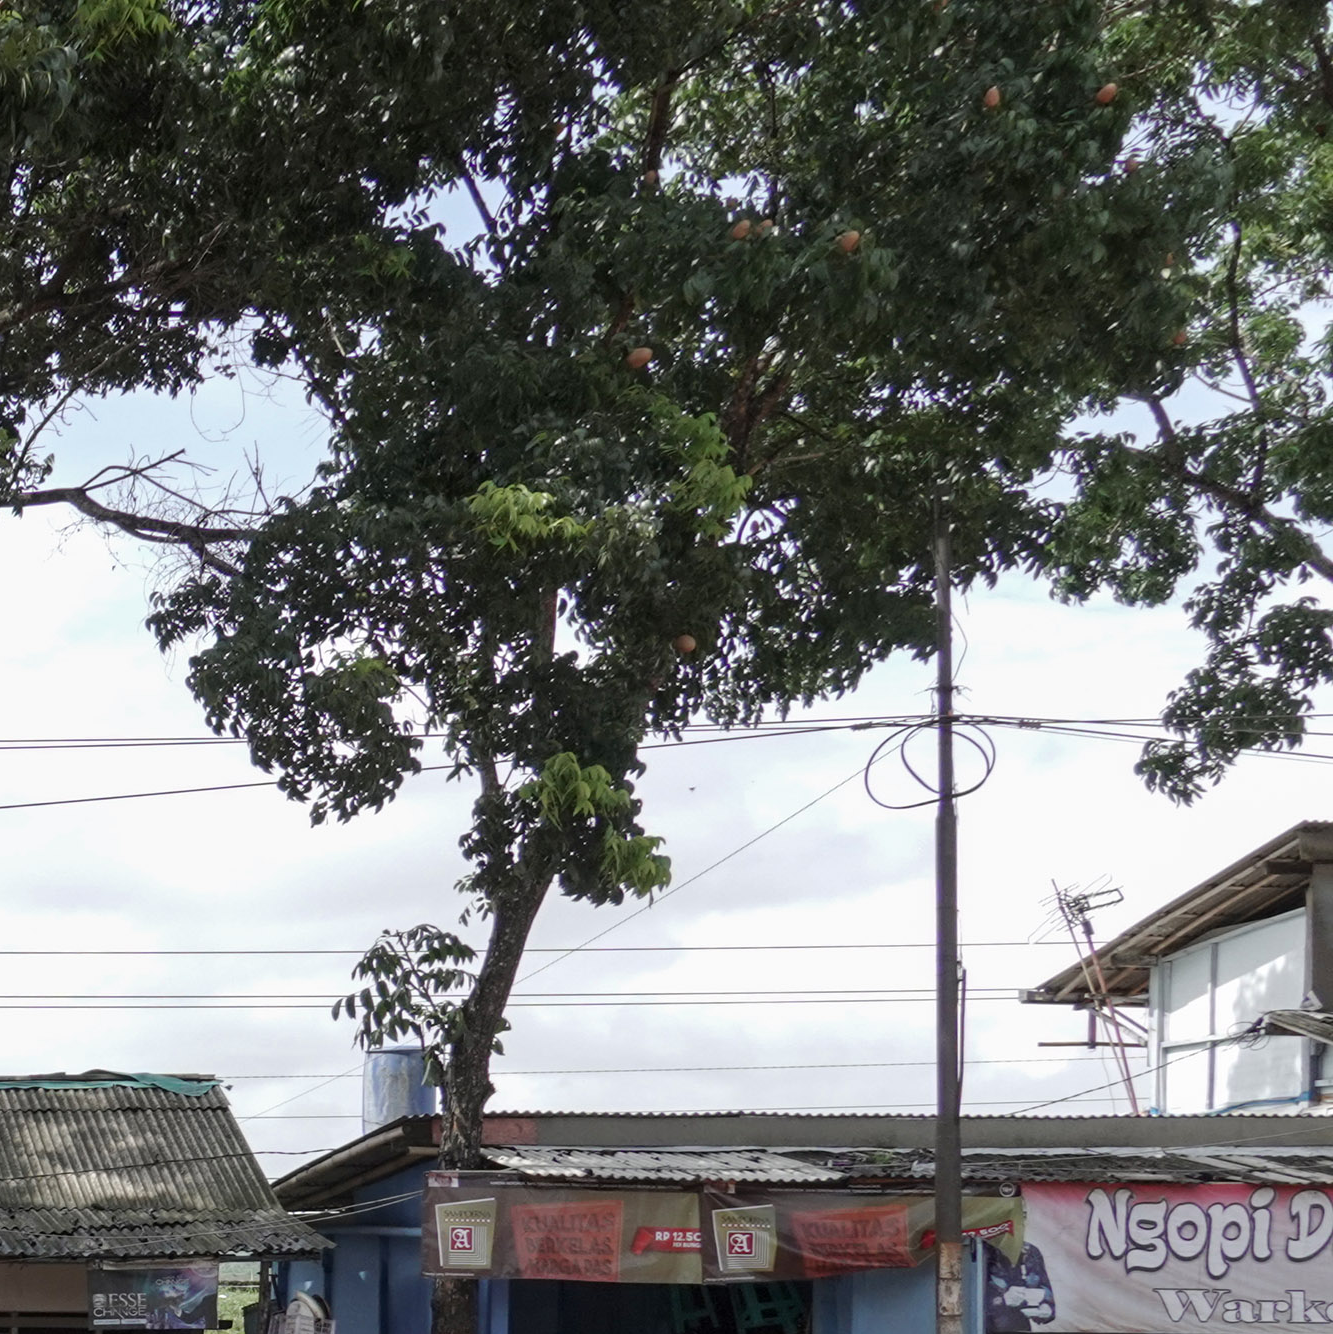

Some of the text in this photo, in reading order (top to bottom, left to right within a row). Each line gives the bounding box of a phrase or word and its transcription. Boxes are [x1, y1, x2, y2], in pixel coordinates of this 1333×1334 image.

[522, 1212, 615, 1233] KUALITAS
[655, 1231, 671, 1241] RP
[1085, 1187, 1275, 1280] Ngopi
[525, 1236, 613, 1255] BERKELAS
[108, 1292, 147, 1308] ESSE
